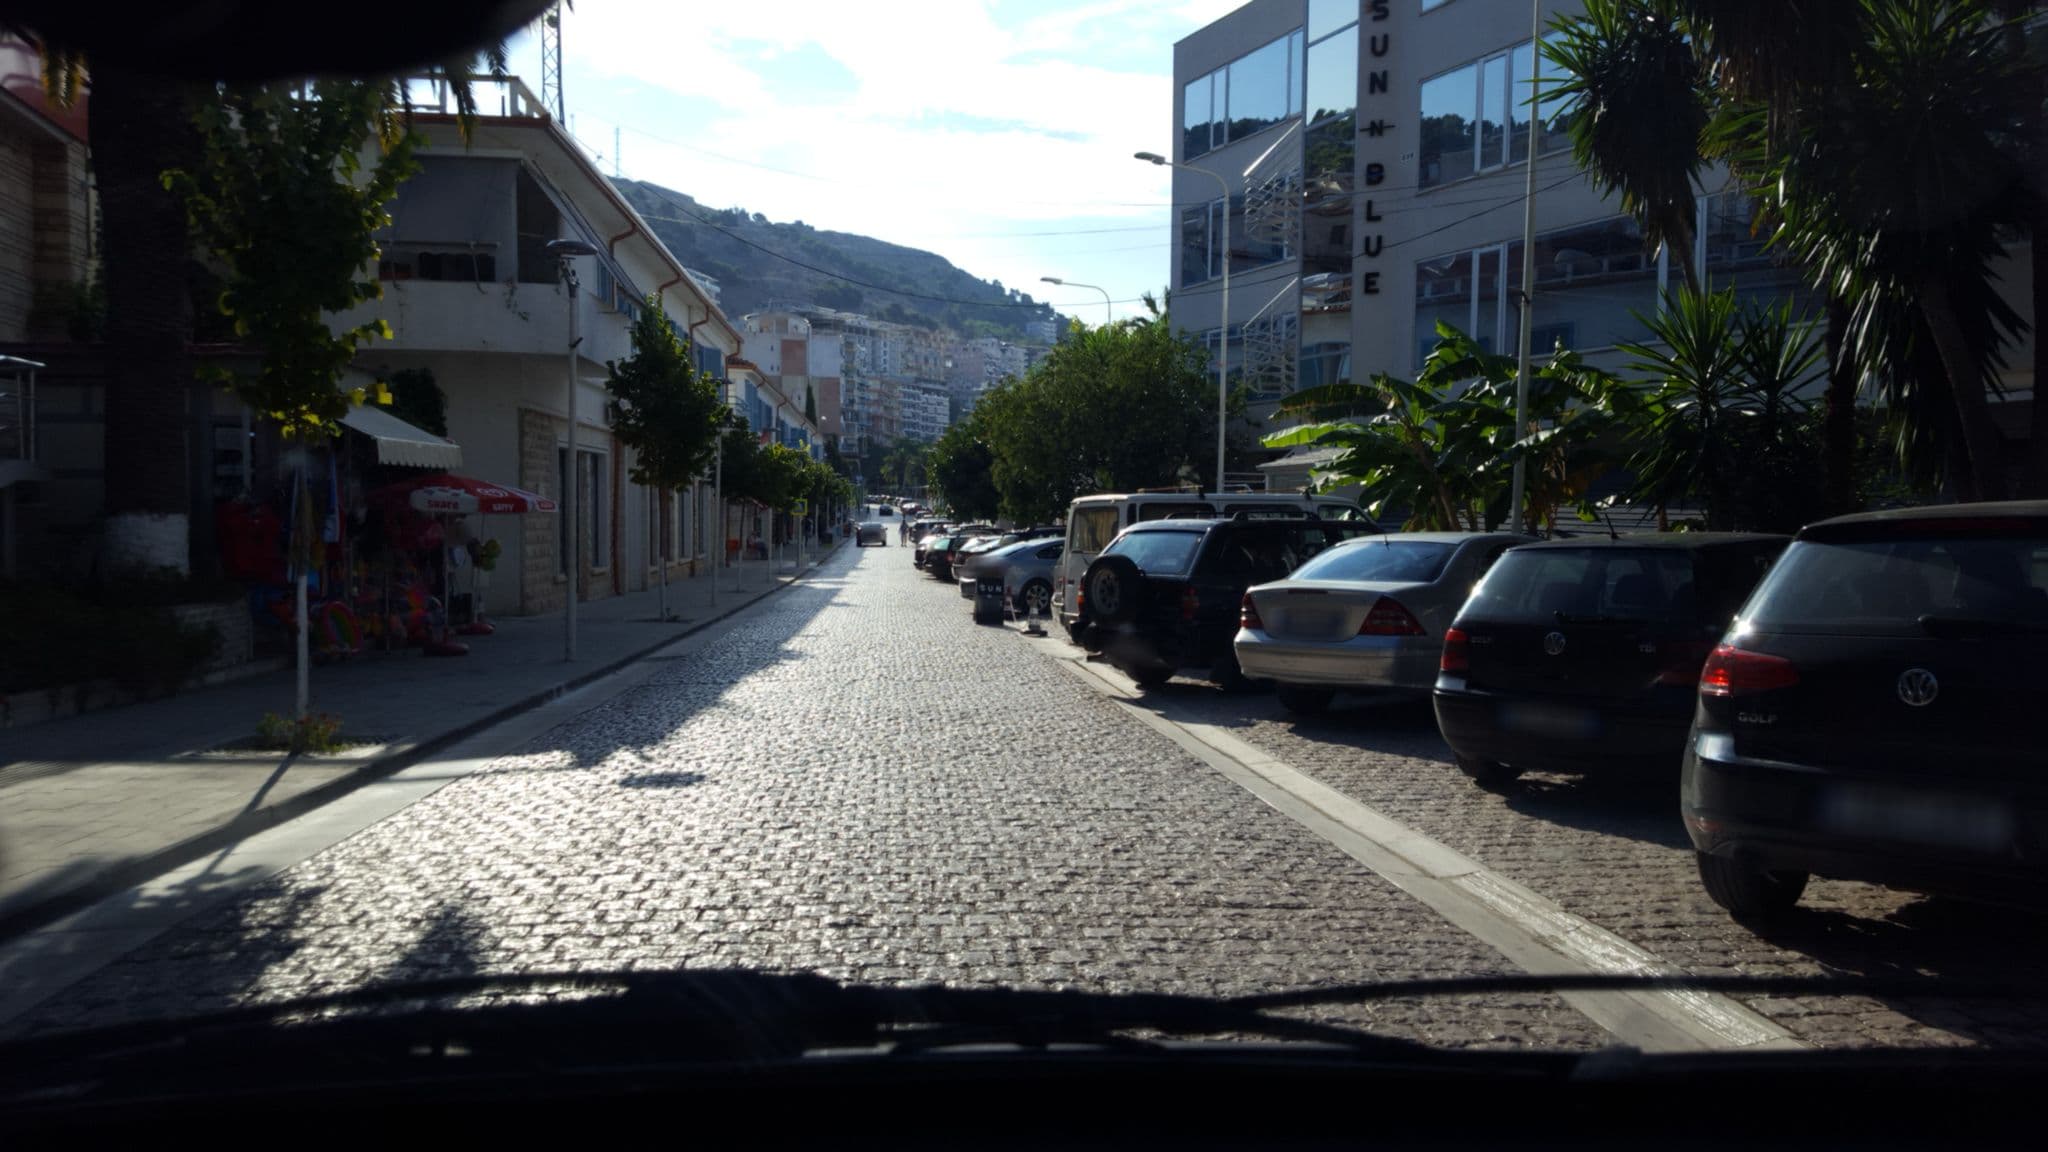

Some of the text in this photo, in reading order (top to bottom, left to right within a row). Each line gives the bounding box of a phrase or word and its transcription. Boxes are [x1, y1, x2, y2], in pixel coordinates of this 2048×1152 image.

[1369, 0, 1390, 95] SUN
[1364, 164, 1384, 295] BLUE
[1737, 711, 1778, 724] GOLF
